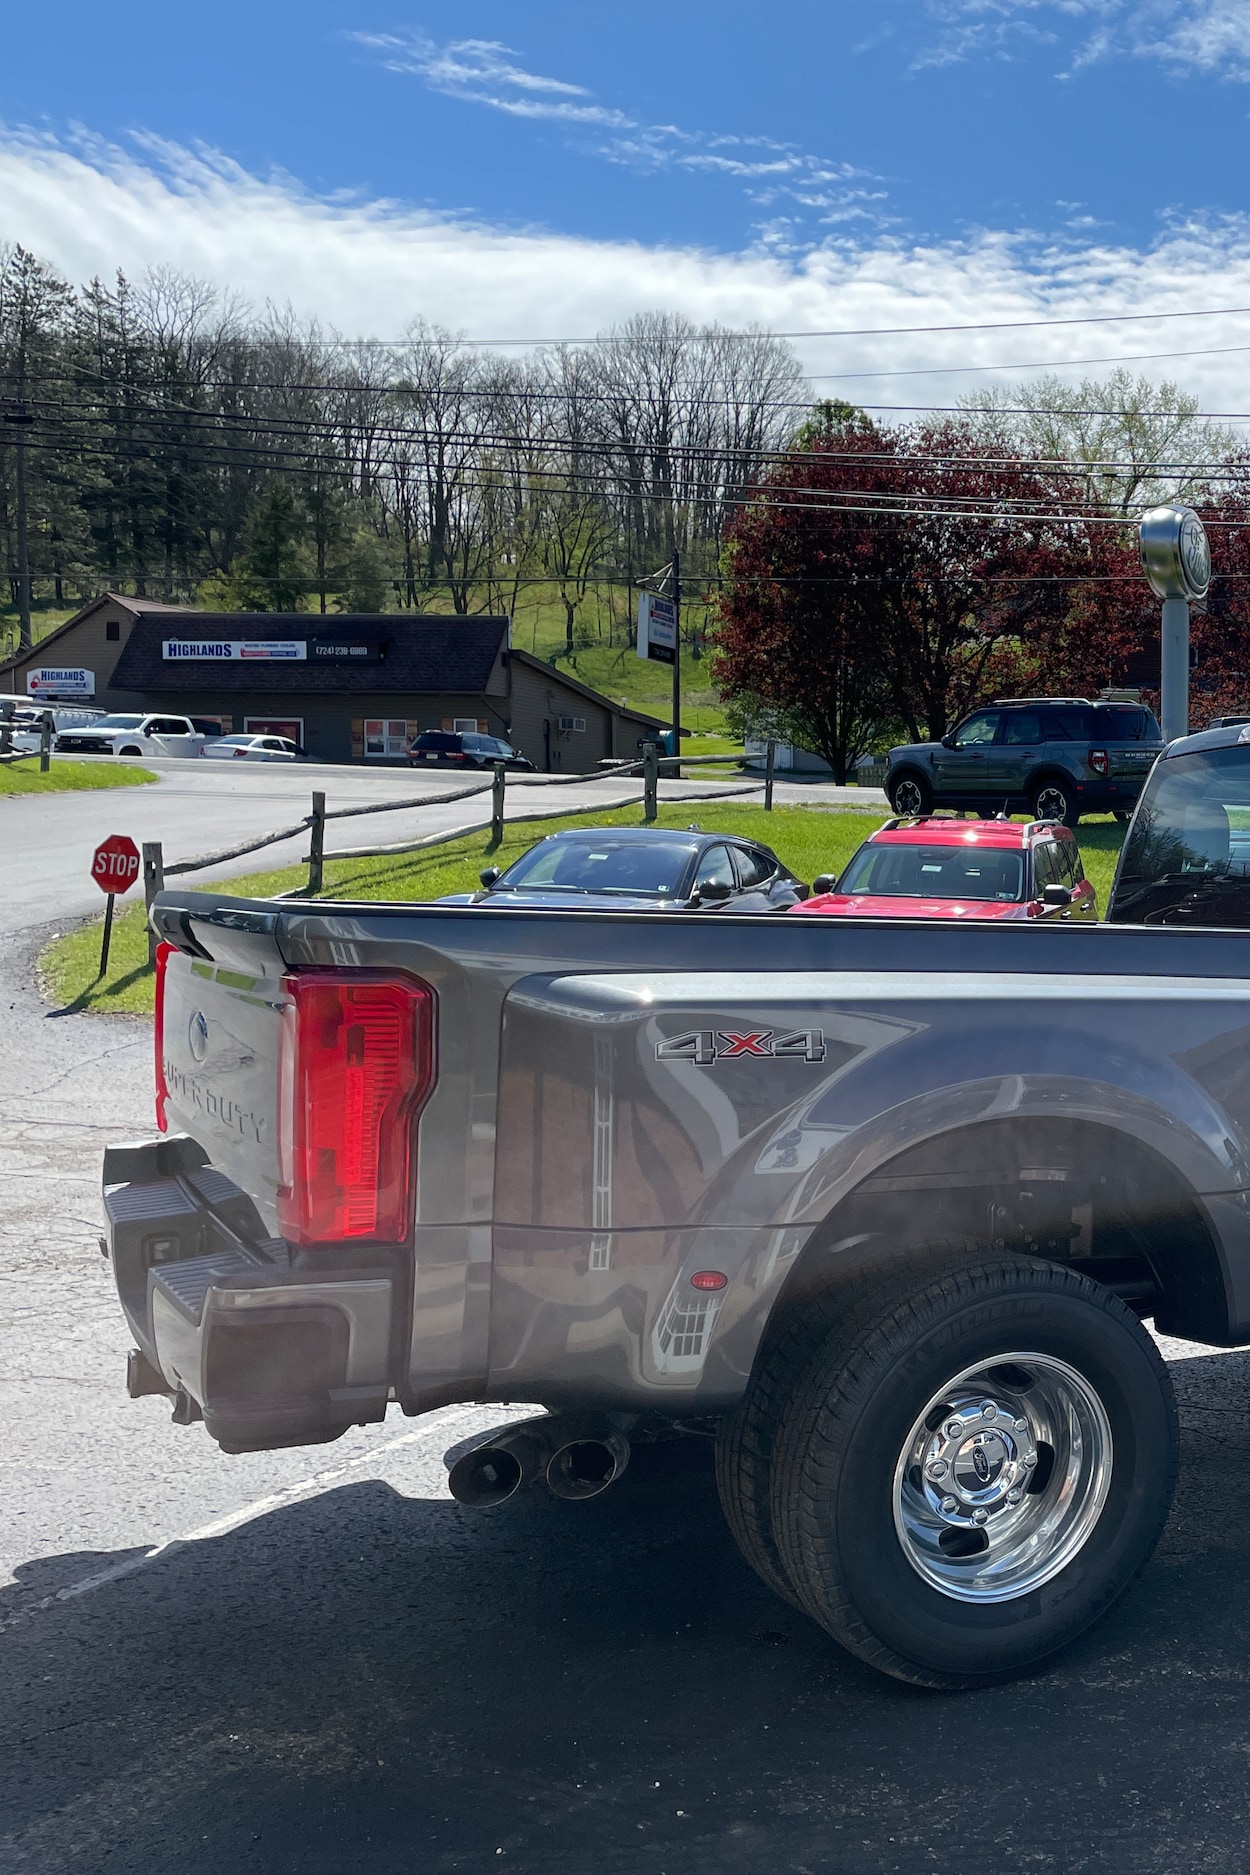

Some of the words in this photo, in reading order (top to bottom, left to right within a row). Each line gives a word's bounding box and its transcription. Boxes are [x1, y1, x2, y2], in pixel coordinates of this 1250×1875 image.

[167, 643, 232, 658] HIGHLANDS
[41, 670, 85, 682] HIGHLANDS
[95, 851, 138, 877] STOP
[206, 1088, 265, 1145] DUTY
